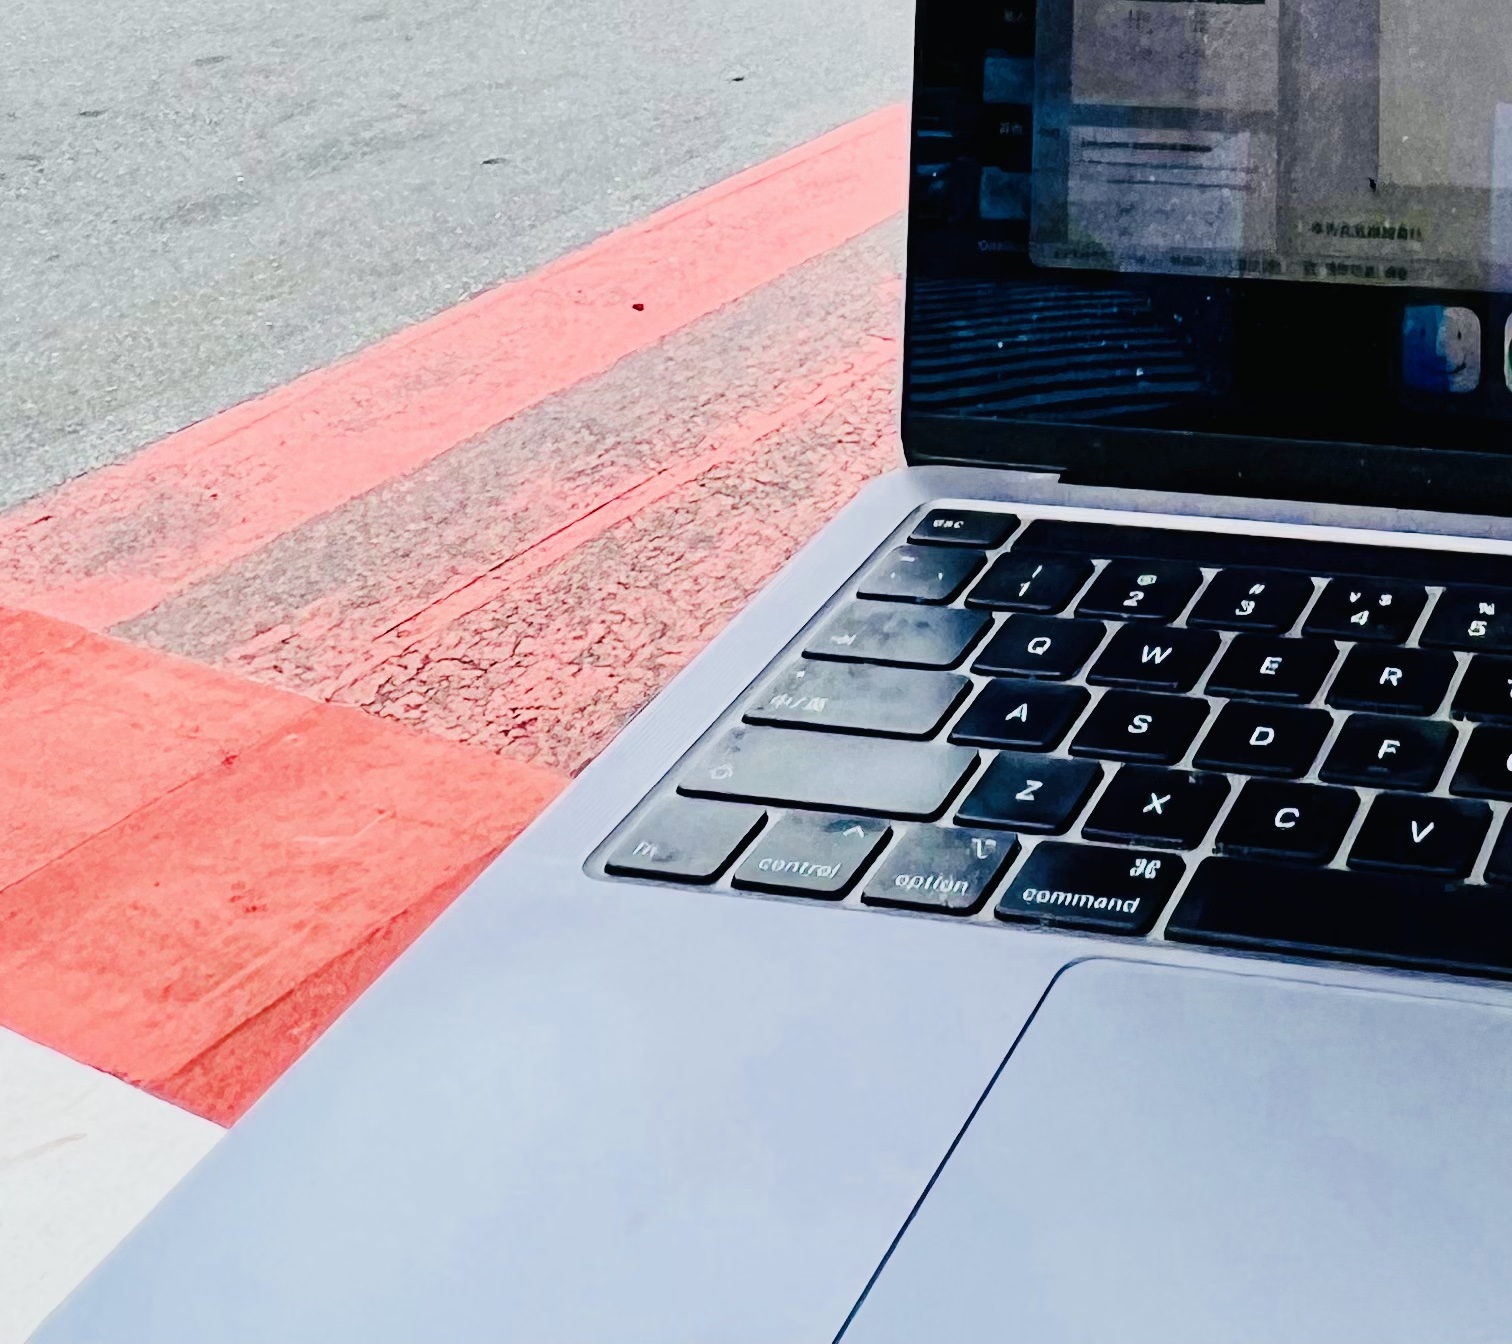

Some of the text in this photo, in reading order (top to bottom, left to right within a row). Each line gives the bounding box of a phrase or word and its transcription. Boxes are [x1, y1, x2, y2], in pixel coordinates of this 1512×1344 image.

[1017, 580, 1034, 598] 1
[1122, 590, 1145, 608] 2
[1235, 599, 1257, 616] 3
[1350, 610, 1371, 627] 4
[1467, 620, 1488, 637] 5
[1027, 635, 1052, 656] Q
[1141, 644, 1173, 665] W
[1259, 657, 1283, 676] E
[1378, 667, 1404, 687] R
[1004, 703, 1029, 724] A
[1127, 714, 1153, 734] S
[1249, 726, 1276, 747] D
[1377, 739, 1401, 760] F
[1014, 780, 1043, 801] Z
[1142, 792, 1172, 815] X
[1273, 807, 1300, 830] C
[1410, 820, 1435, 844] V
[757, 855, 842, 879] control
[894, 871, 969, 896] option
[1021, 886, 1141, 915] command
